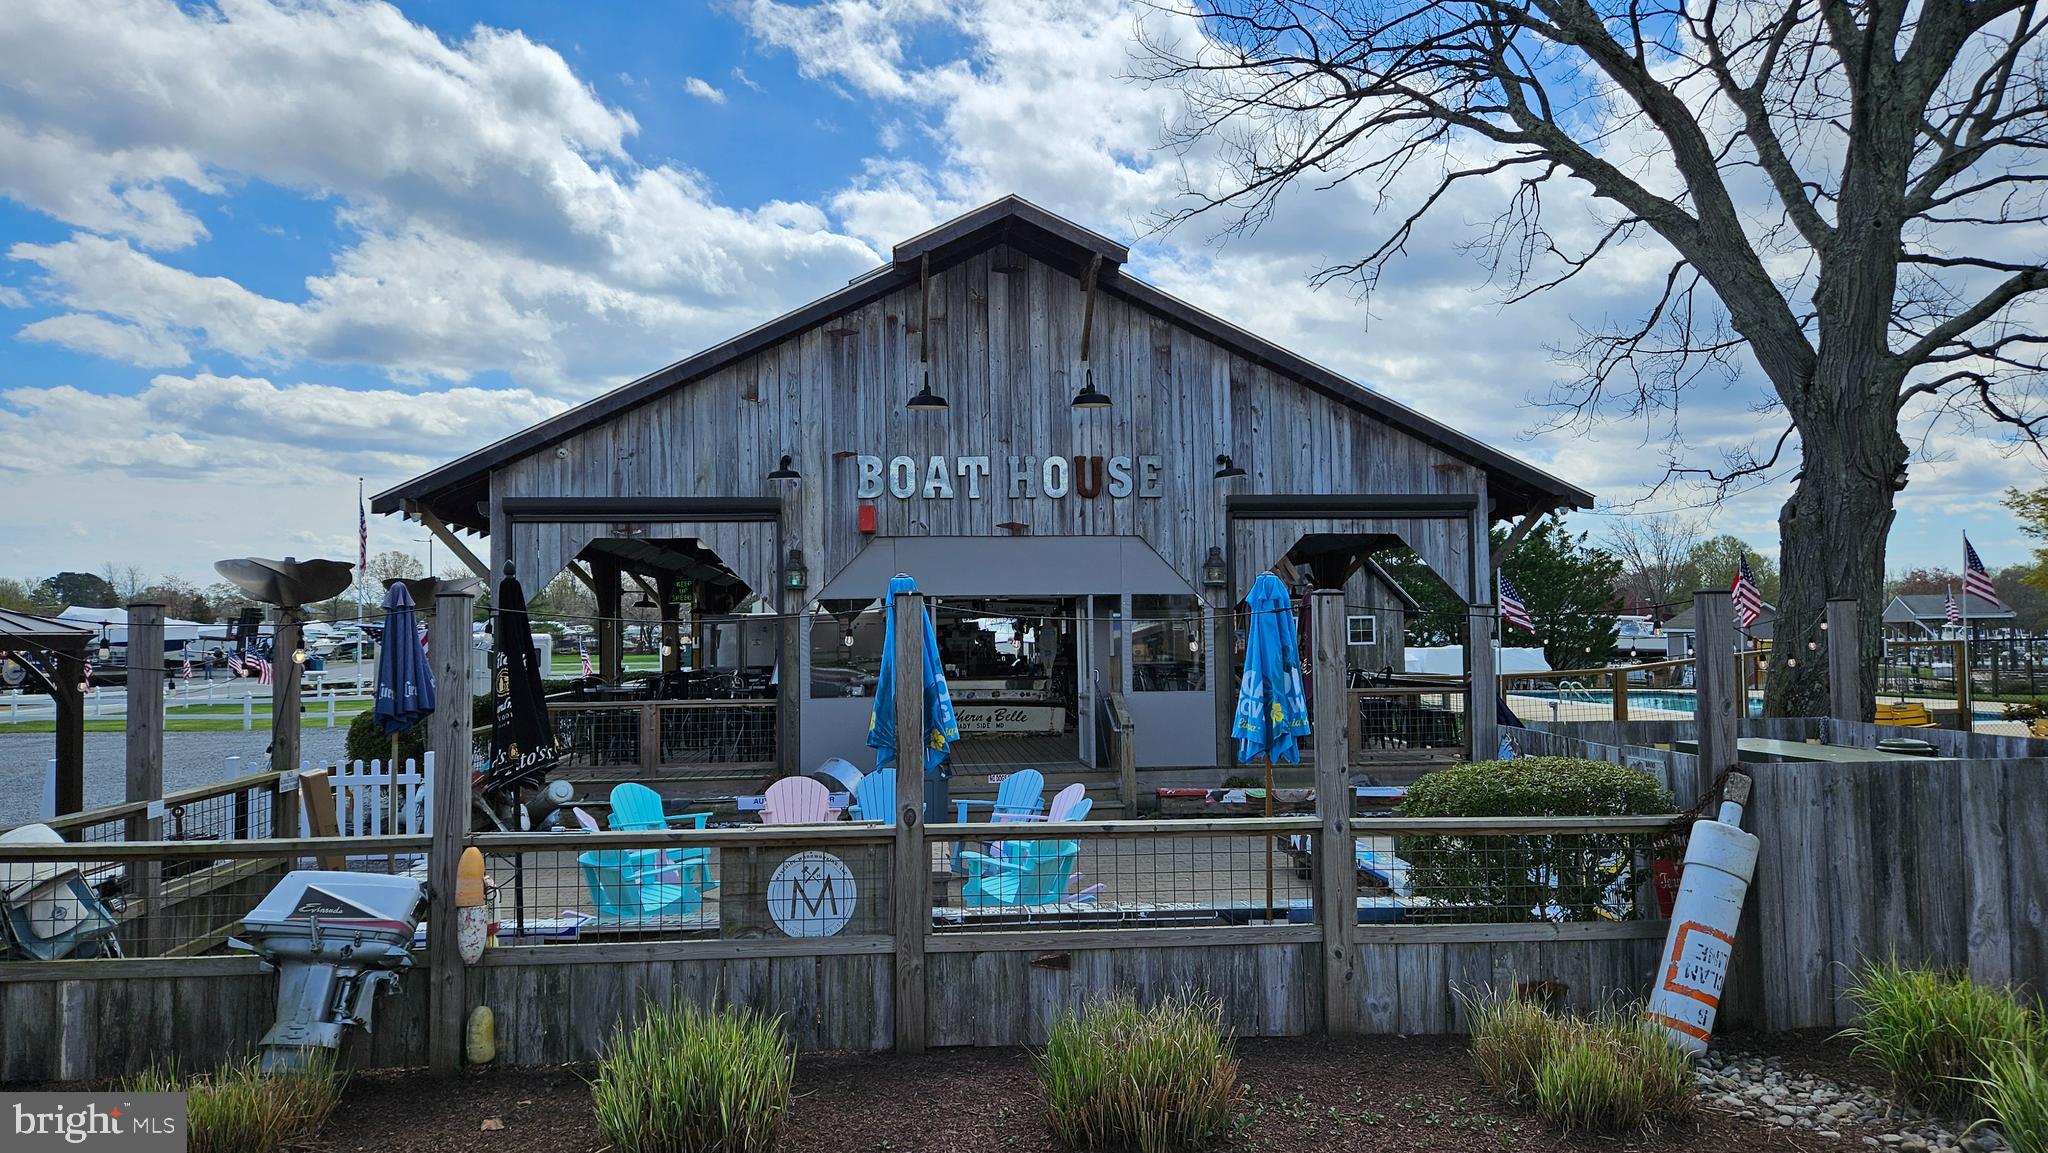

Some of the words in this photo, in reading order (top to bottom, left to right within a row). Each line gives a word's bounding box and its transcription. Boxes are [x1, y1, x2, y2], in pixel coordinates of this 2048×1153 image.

[857, 455, 989, 499] BOAT
[1008, 455, 1163, 499] HOUSE
[994, 708, 1028, 722] Belle
[790, 873, 838, 919] M
[1685, 961, 1723, 991] CLAM
